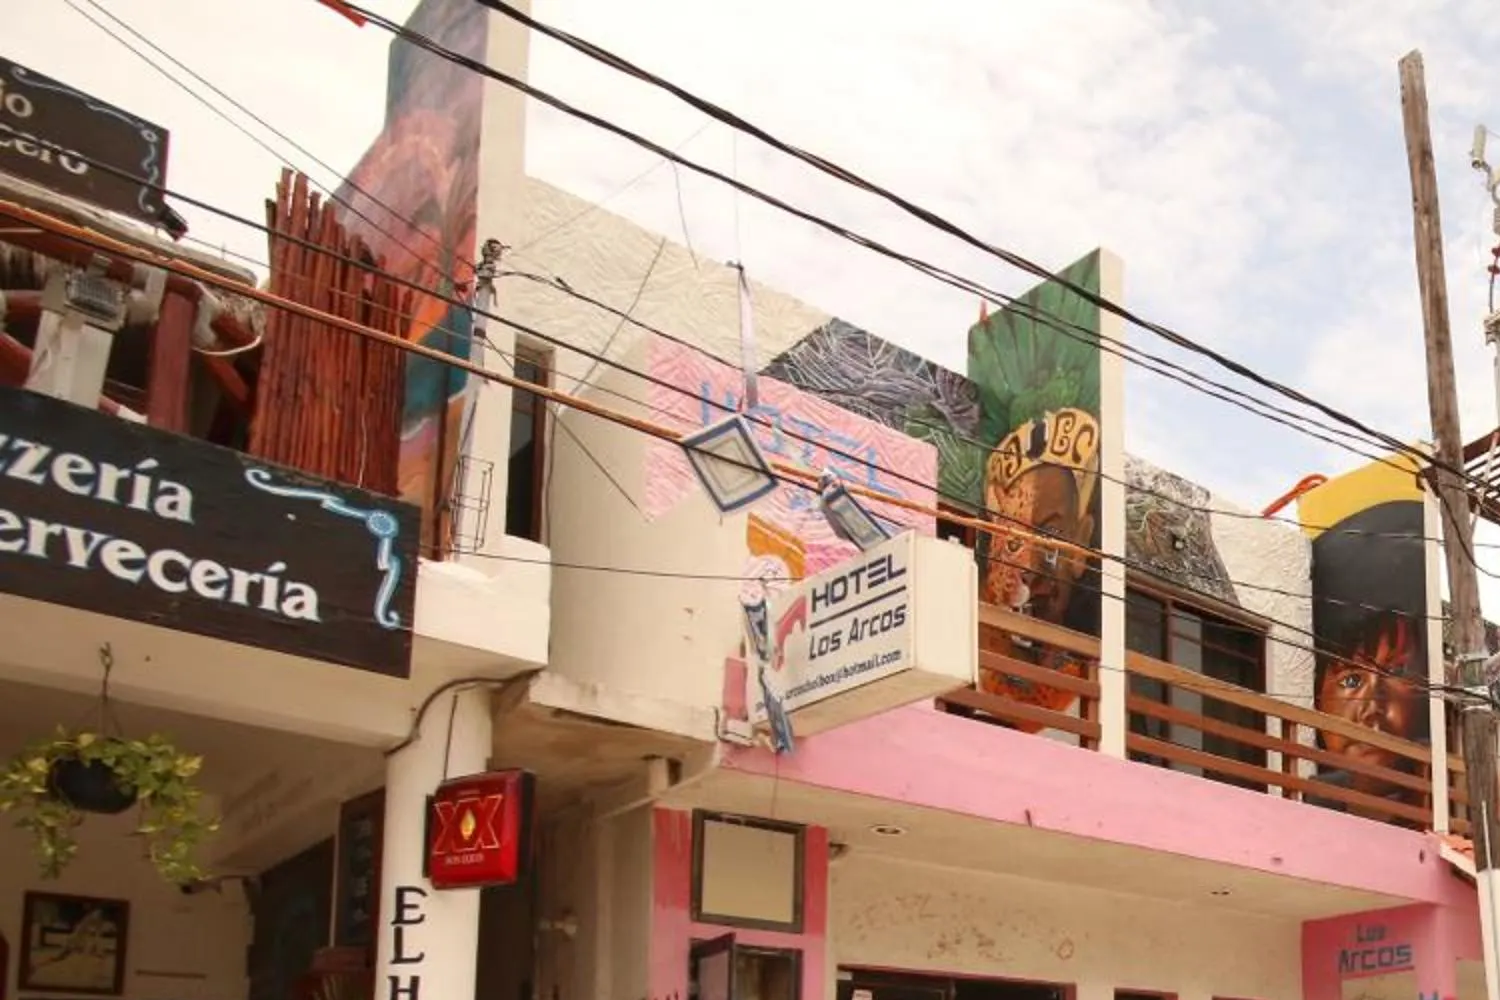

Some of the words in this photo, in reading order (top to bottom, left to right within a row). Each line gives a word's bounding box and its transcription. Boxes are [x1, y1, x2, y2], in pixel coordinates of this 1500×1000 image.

[811, 553, 907, 613] HOTEL
[809, 630, 843, 661] Los
[847, 604, 907, 646] Arcos
[389, 886, 428, 965] EL
